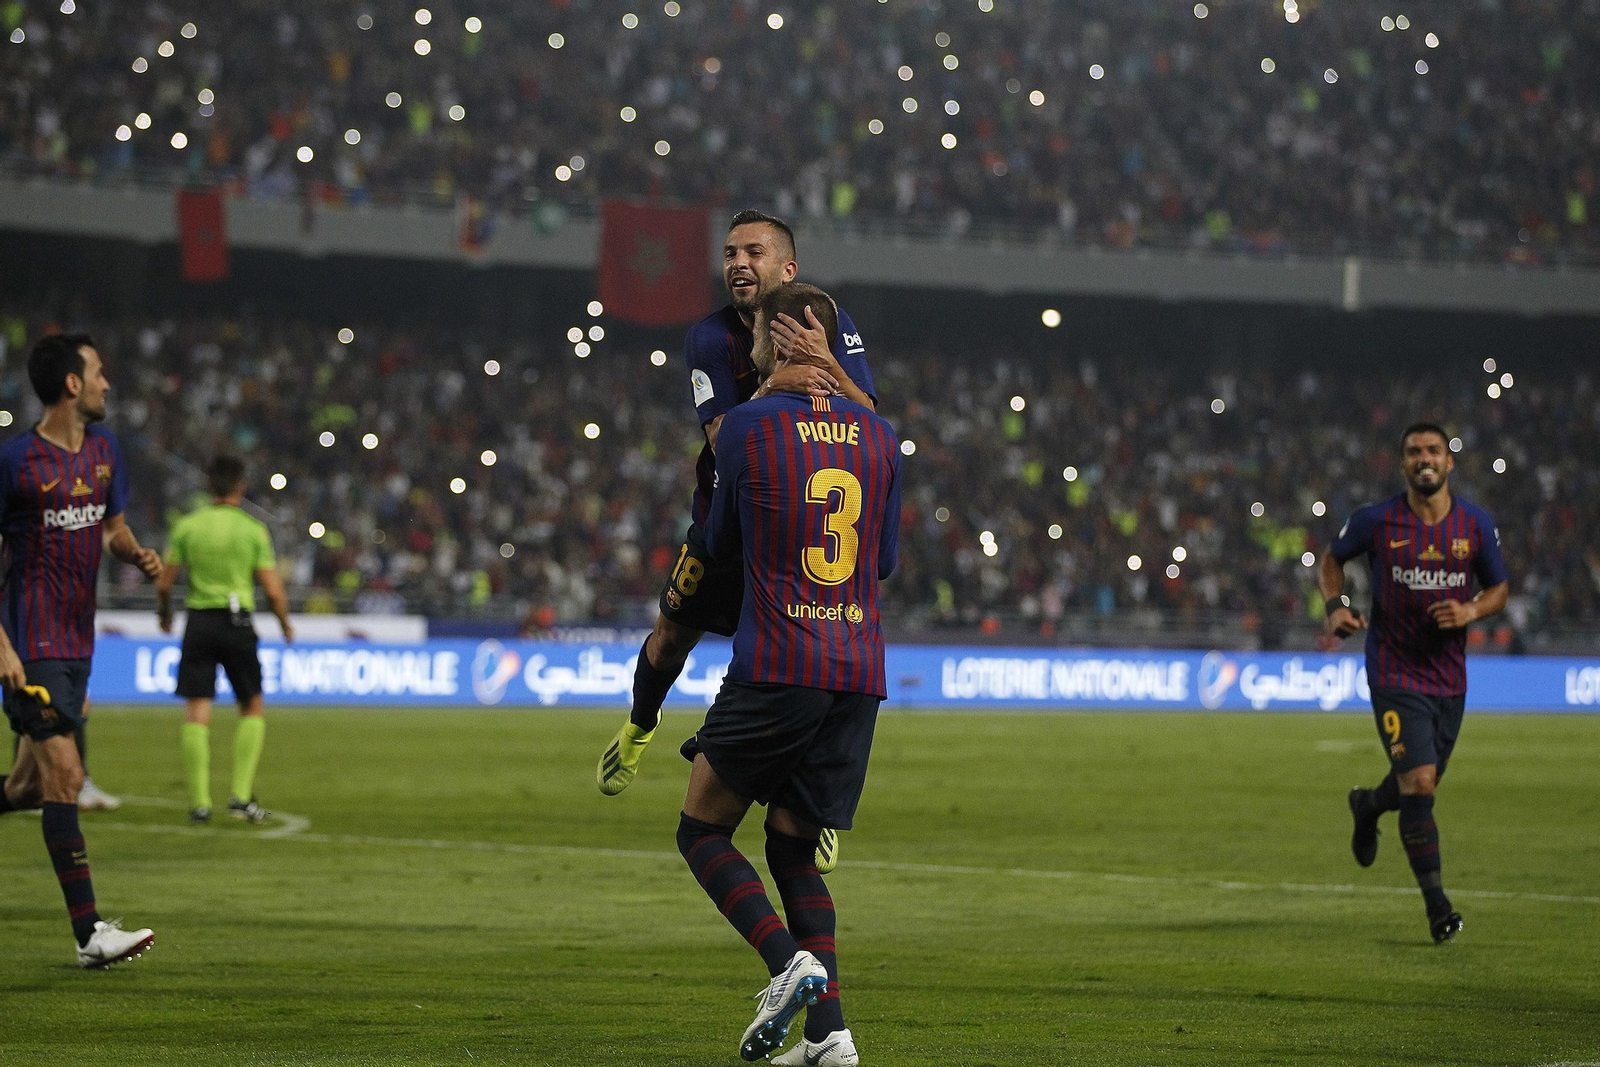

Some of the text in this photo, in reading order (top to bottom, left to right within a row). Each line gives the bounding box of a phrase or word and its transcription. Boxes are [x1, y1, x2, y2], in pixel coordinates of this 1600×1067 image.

[795, 420, 861, 447] PIQUÉ
[43, 502, 107, 531] Rakute
[801, 467, 862, 587] 3
[671, 543, 705, 597] 18
[1391, 564, 1467, 591] Rakuten
[787, 600, 844, 622] unicef
[281, 647, 460, 696] NATIONALE
[1050, 657, 1190, 701] NATIONALE
[1383, 710, 1401, 744] 9
